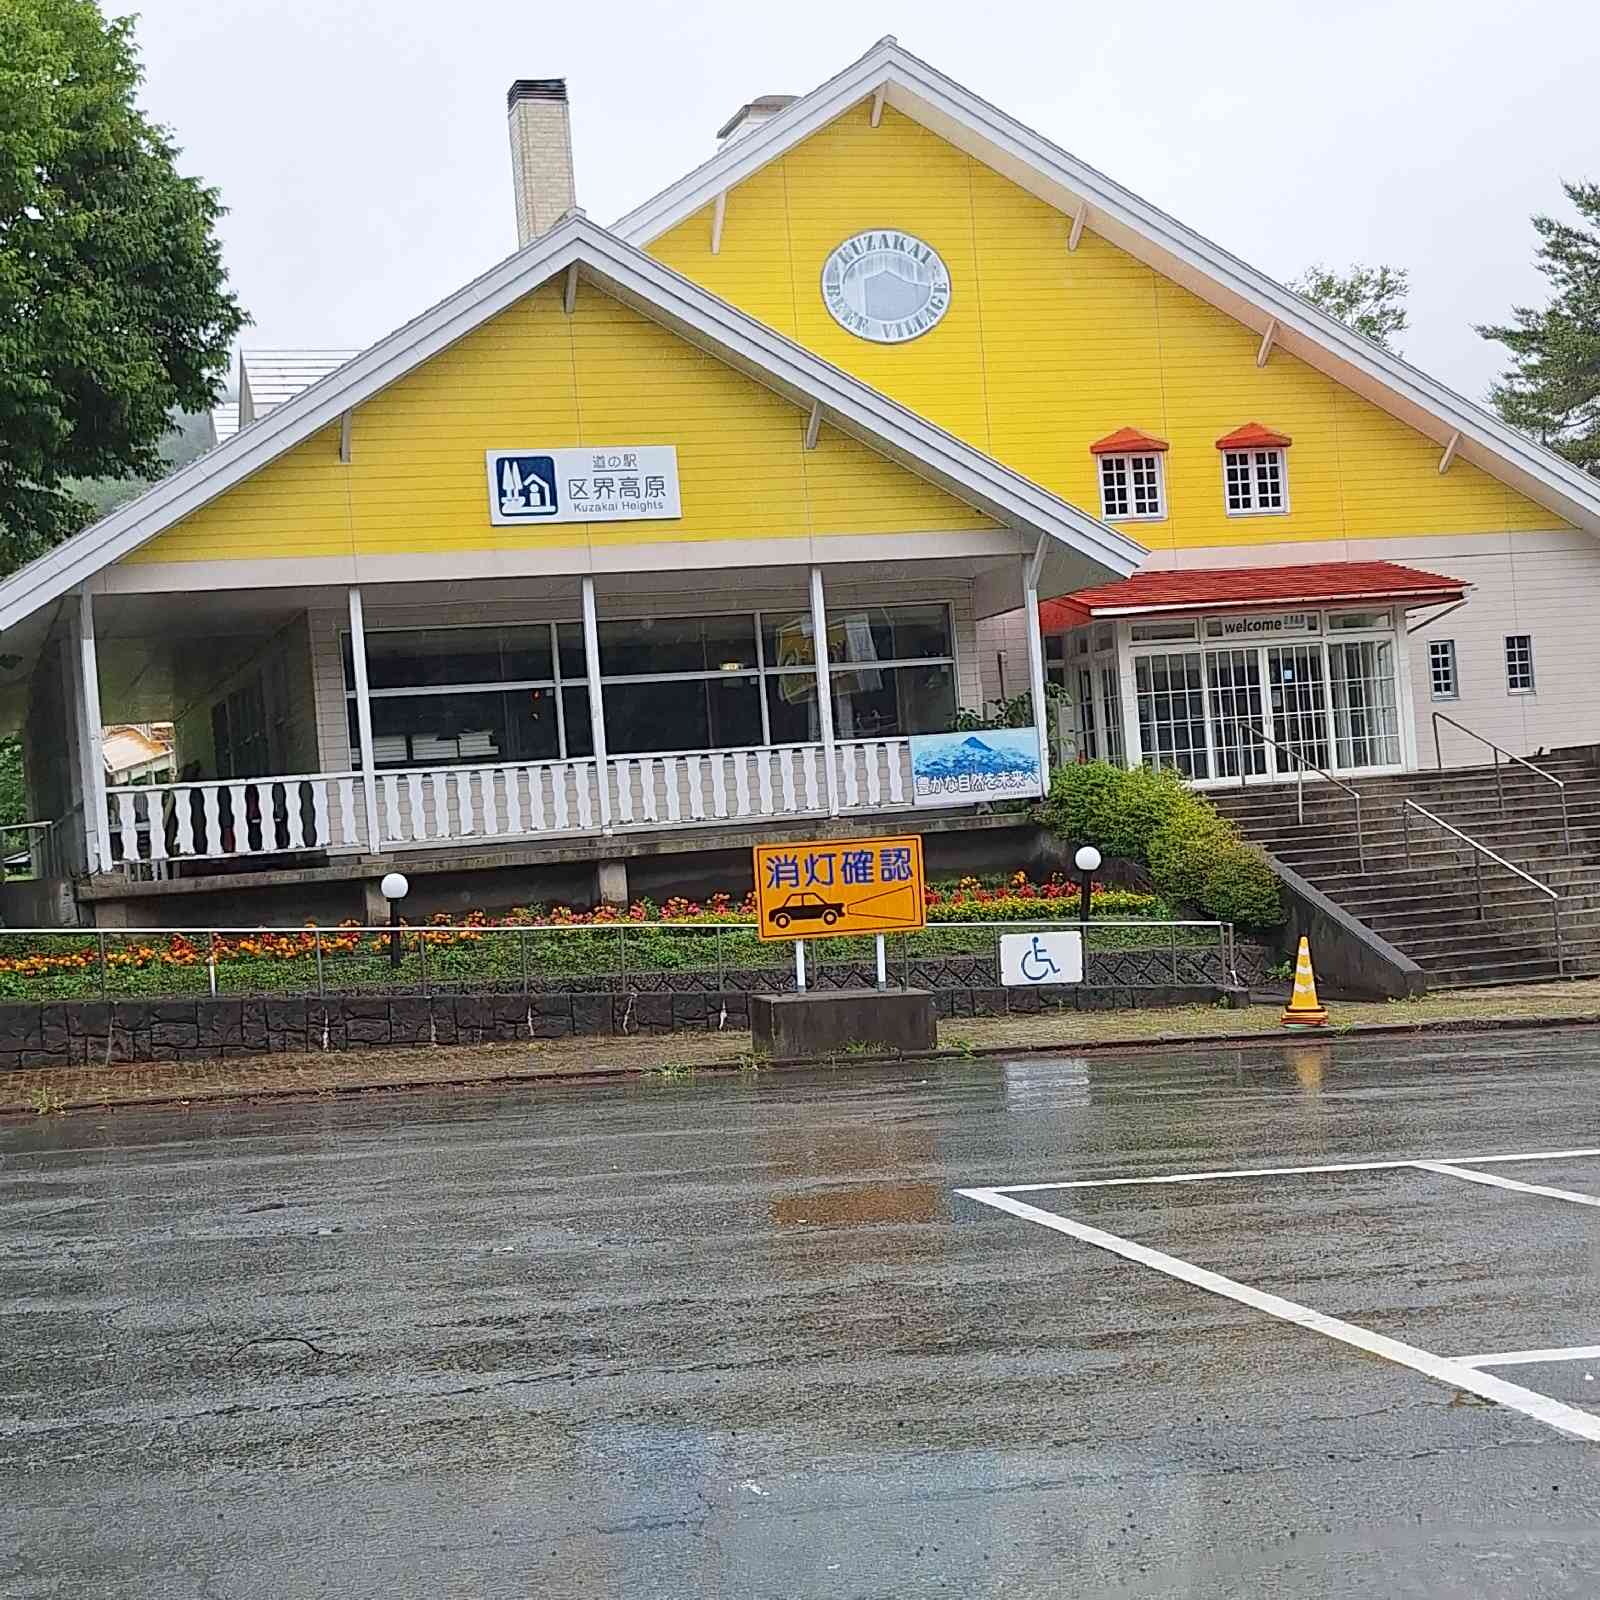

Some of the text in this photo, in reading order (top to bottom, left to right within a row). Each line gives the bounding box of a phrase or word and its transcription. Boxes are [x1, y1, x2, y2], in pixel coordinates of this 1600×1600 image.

[838, 233, 933, 265] KUZAKAI
[881, 282, 948, 338] VILLAGE
[592, 453, 638, 469] 道の駅
[568, 475, 666, 500] 区界高原
[574, 500, 664, 513] Kuzakai Heights
[1224, 618, 1282, 633] welcome
[916, 770, 1039, 796] 豊かな自然を未来へ
[766, 847, 913, 889] 消灯確認
